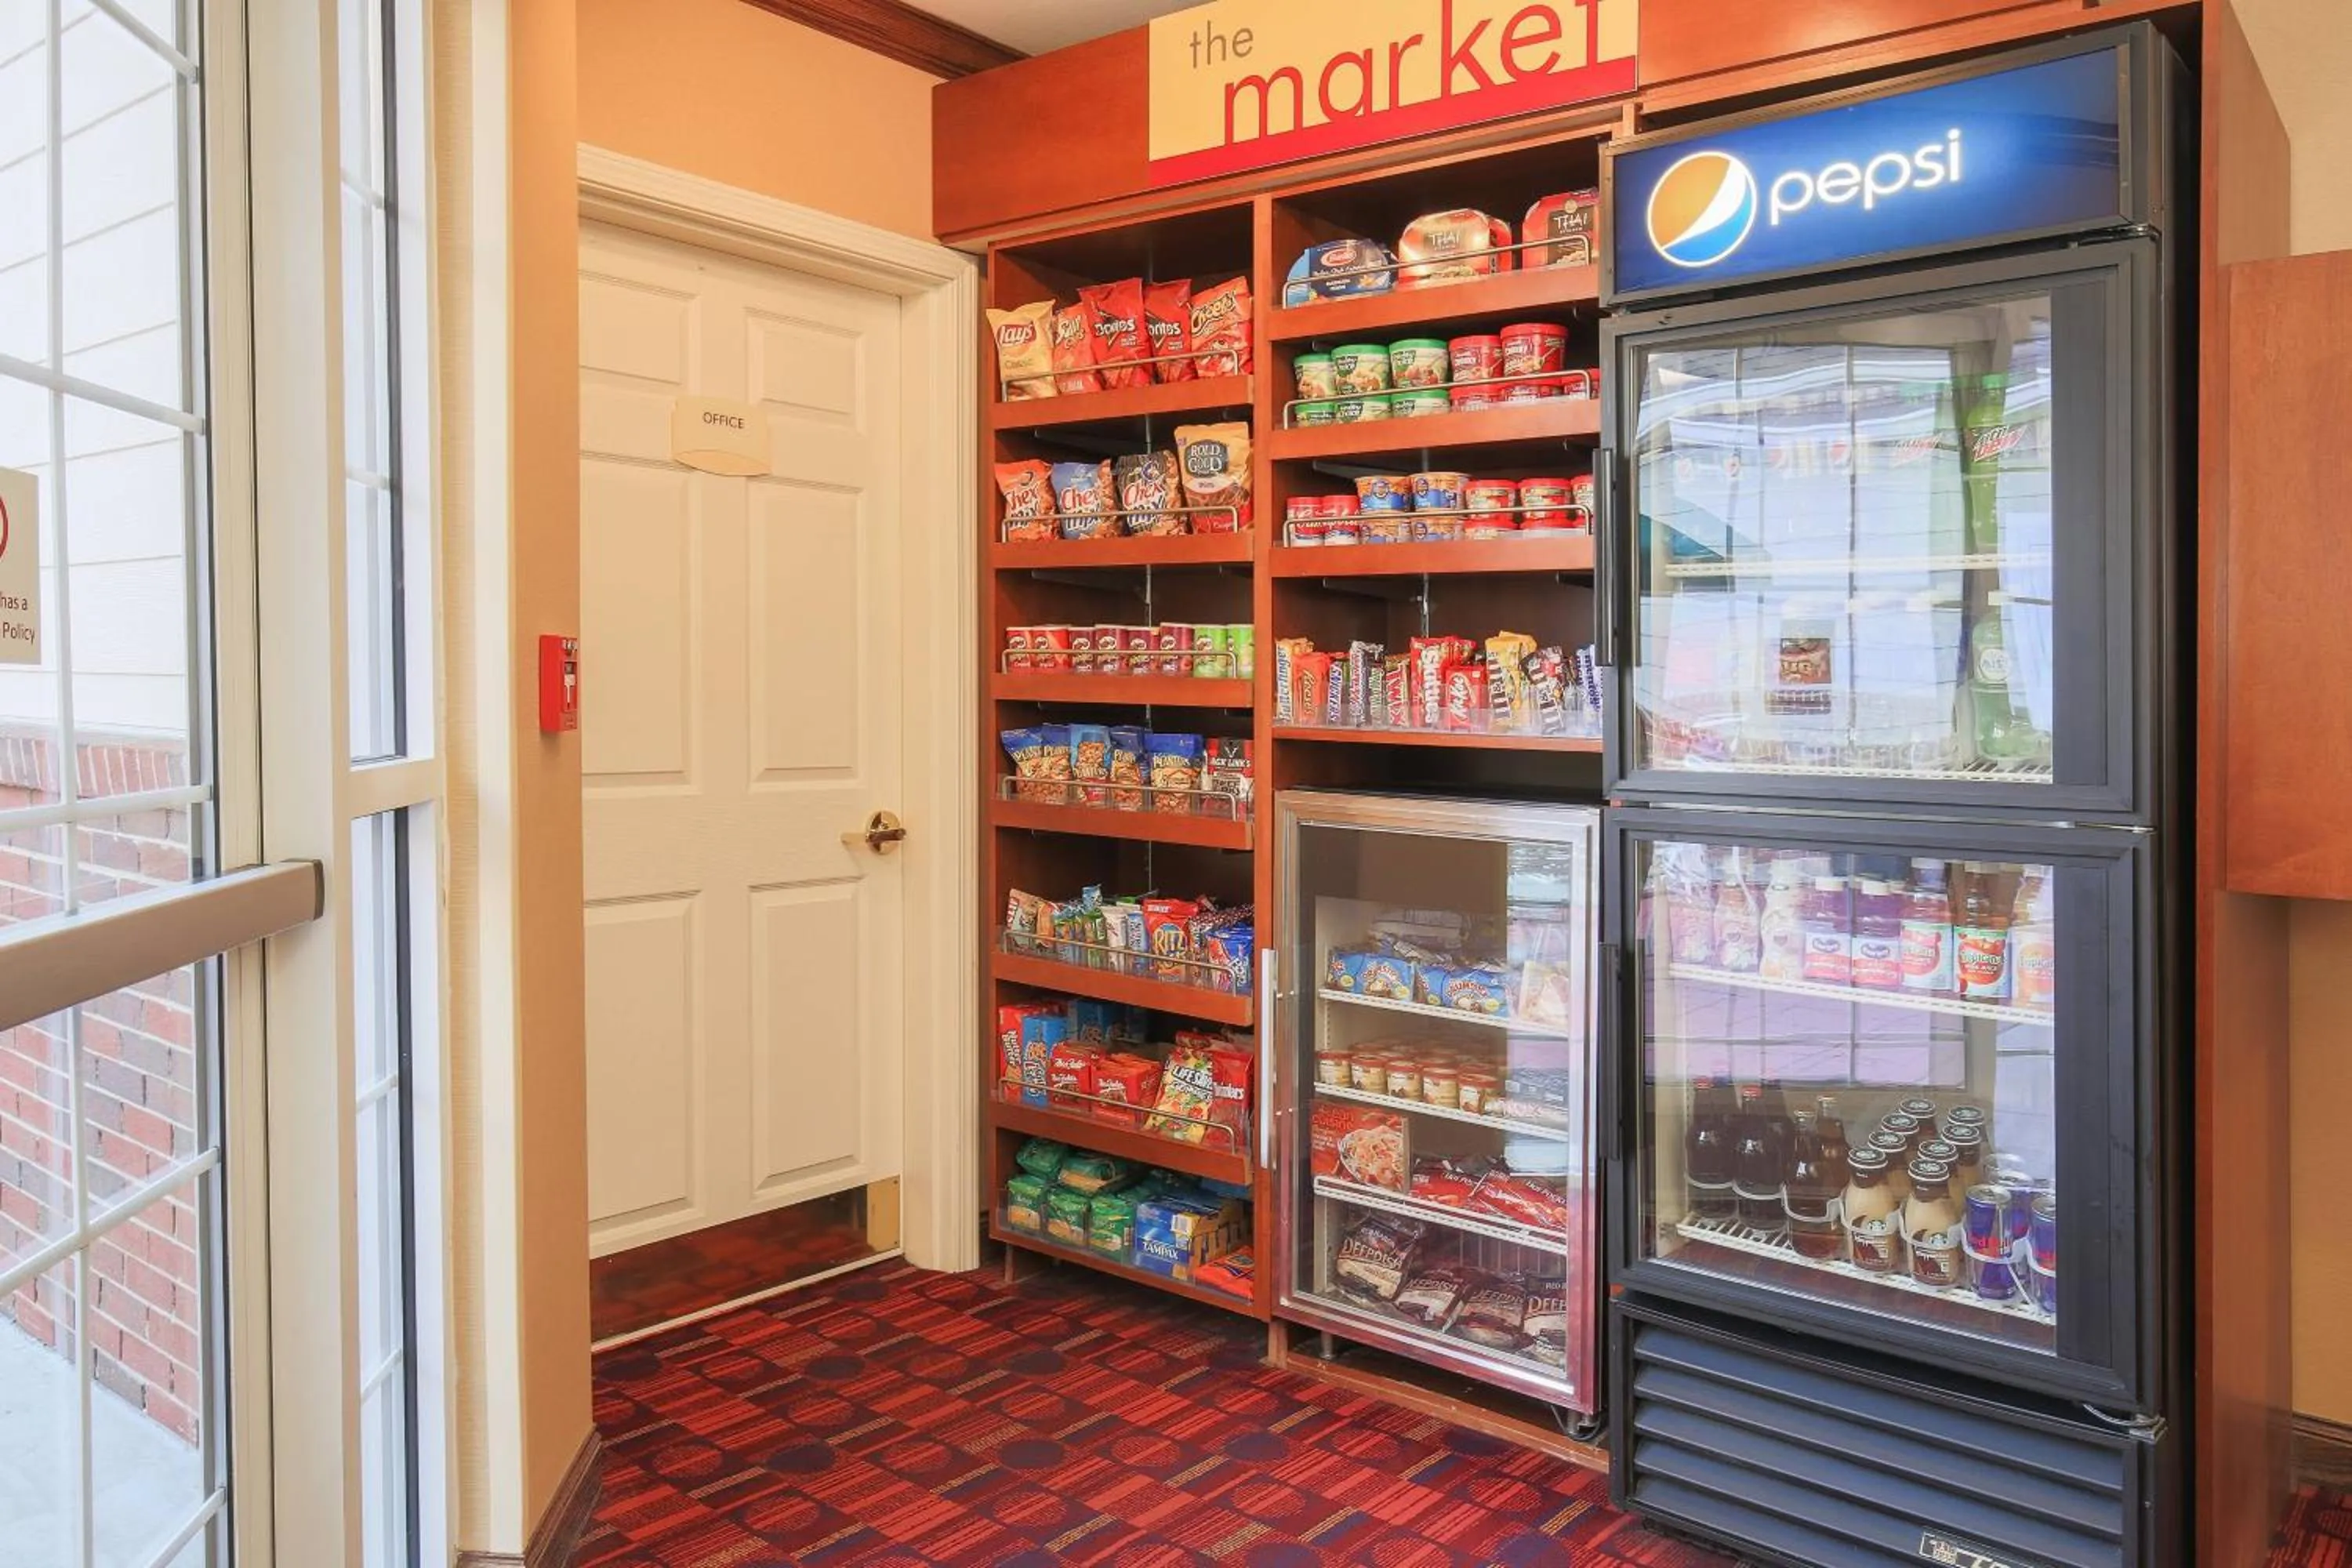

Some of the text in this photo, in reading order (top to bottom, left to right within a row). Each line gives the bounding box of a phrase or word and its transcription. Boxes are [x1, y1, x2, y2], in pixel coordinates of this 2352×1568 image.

[1190, 20, 1254, 68] the
[1225, 0, 1610, 146] market
[1771, 128, 1961, 226] pepsi
[1552, 212, 1588, 230] THAI
[1428, 230, 1460, 246] THAI
[1094, 318, 1136, 336] Doritos
[1148, 322, 1181, 336] oritos
[702, 412, 745, 429] OFFICE
[1004, 485, 1037, 510] hex
[21, 598, 27, 612] a
[2, 622, 35, 645] Policy
[1152, 927, 1185, 956] RITZ
[1142, 1240, 1179, 1261] TAMPAX
